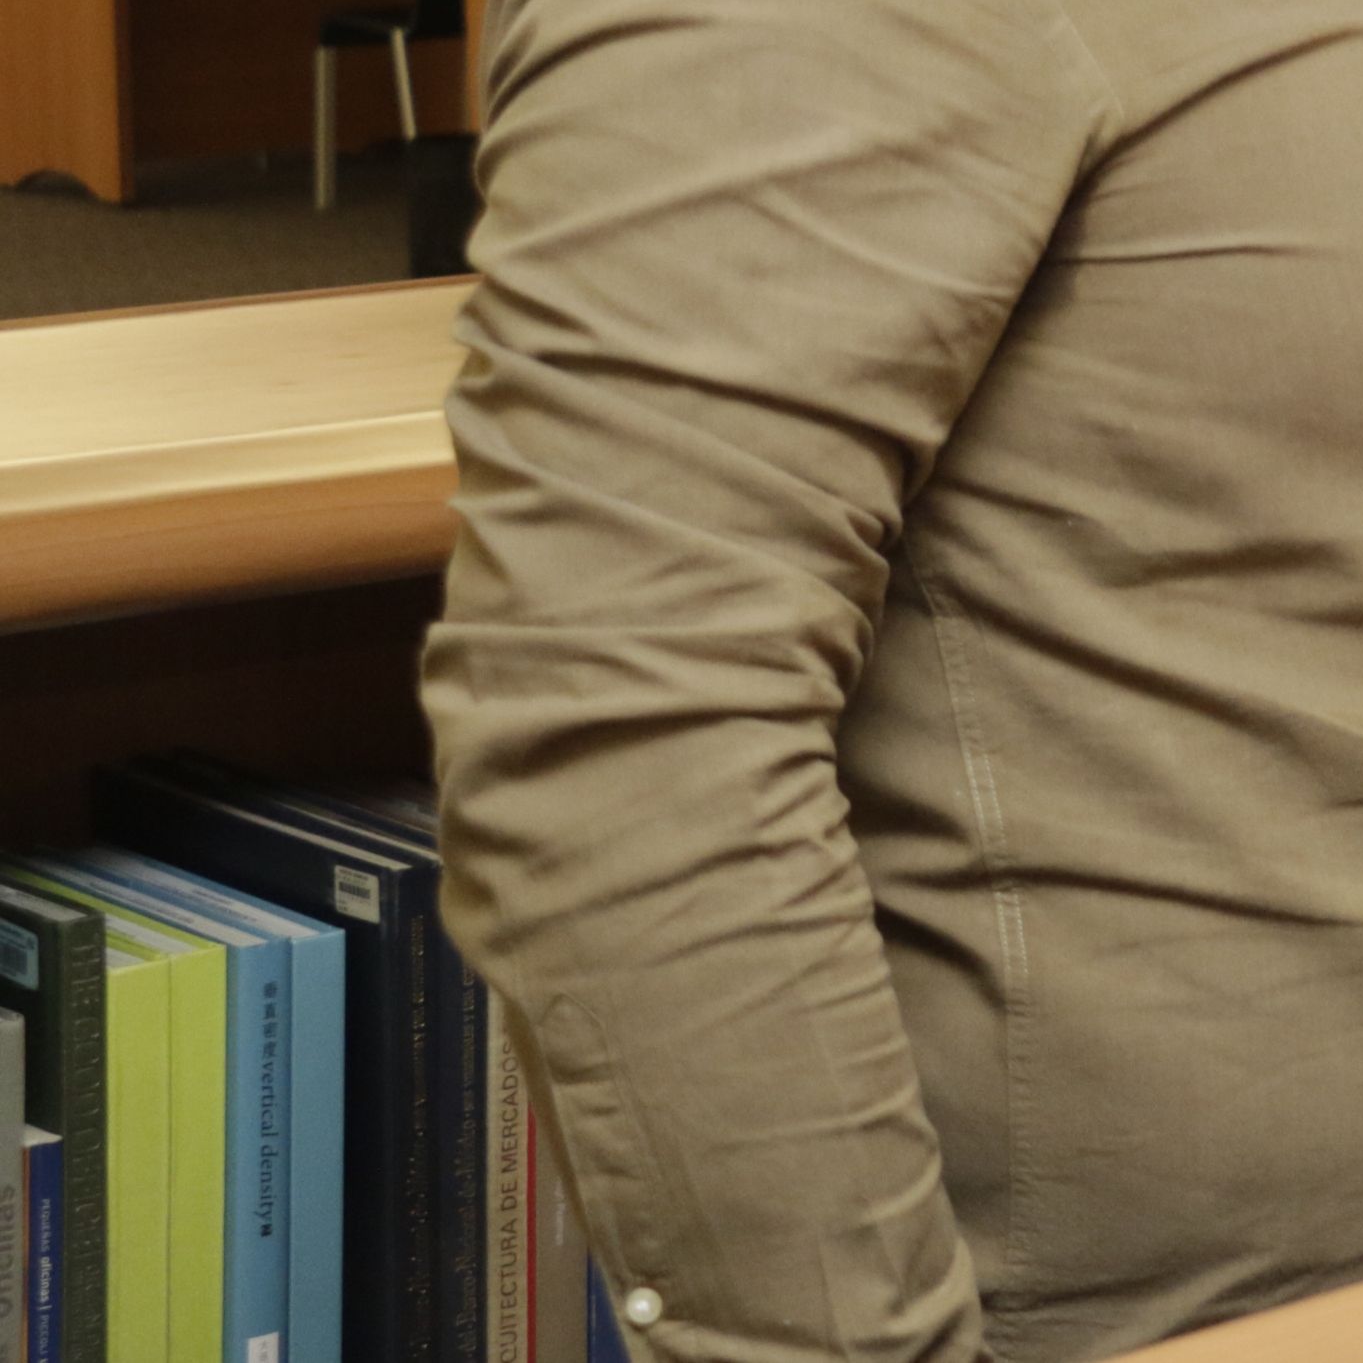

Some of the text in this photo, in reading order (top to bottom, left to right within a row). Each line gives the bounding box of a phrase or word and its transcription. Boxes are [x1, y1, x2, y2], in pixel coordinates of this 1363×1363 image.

[260, 1061, 279, 1136] vertical
[502, 1040, 518, 1174] MERCADOS
[254, 1145, 279, 1217] density
[502, 1178, 518, 1212] DE
[38, 1256, 52, 1303] oficinas
